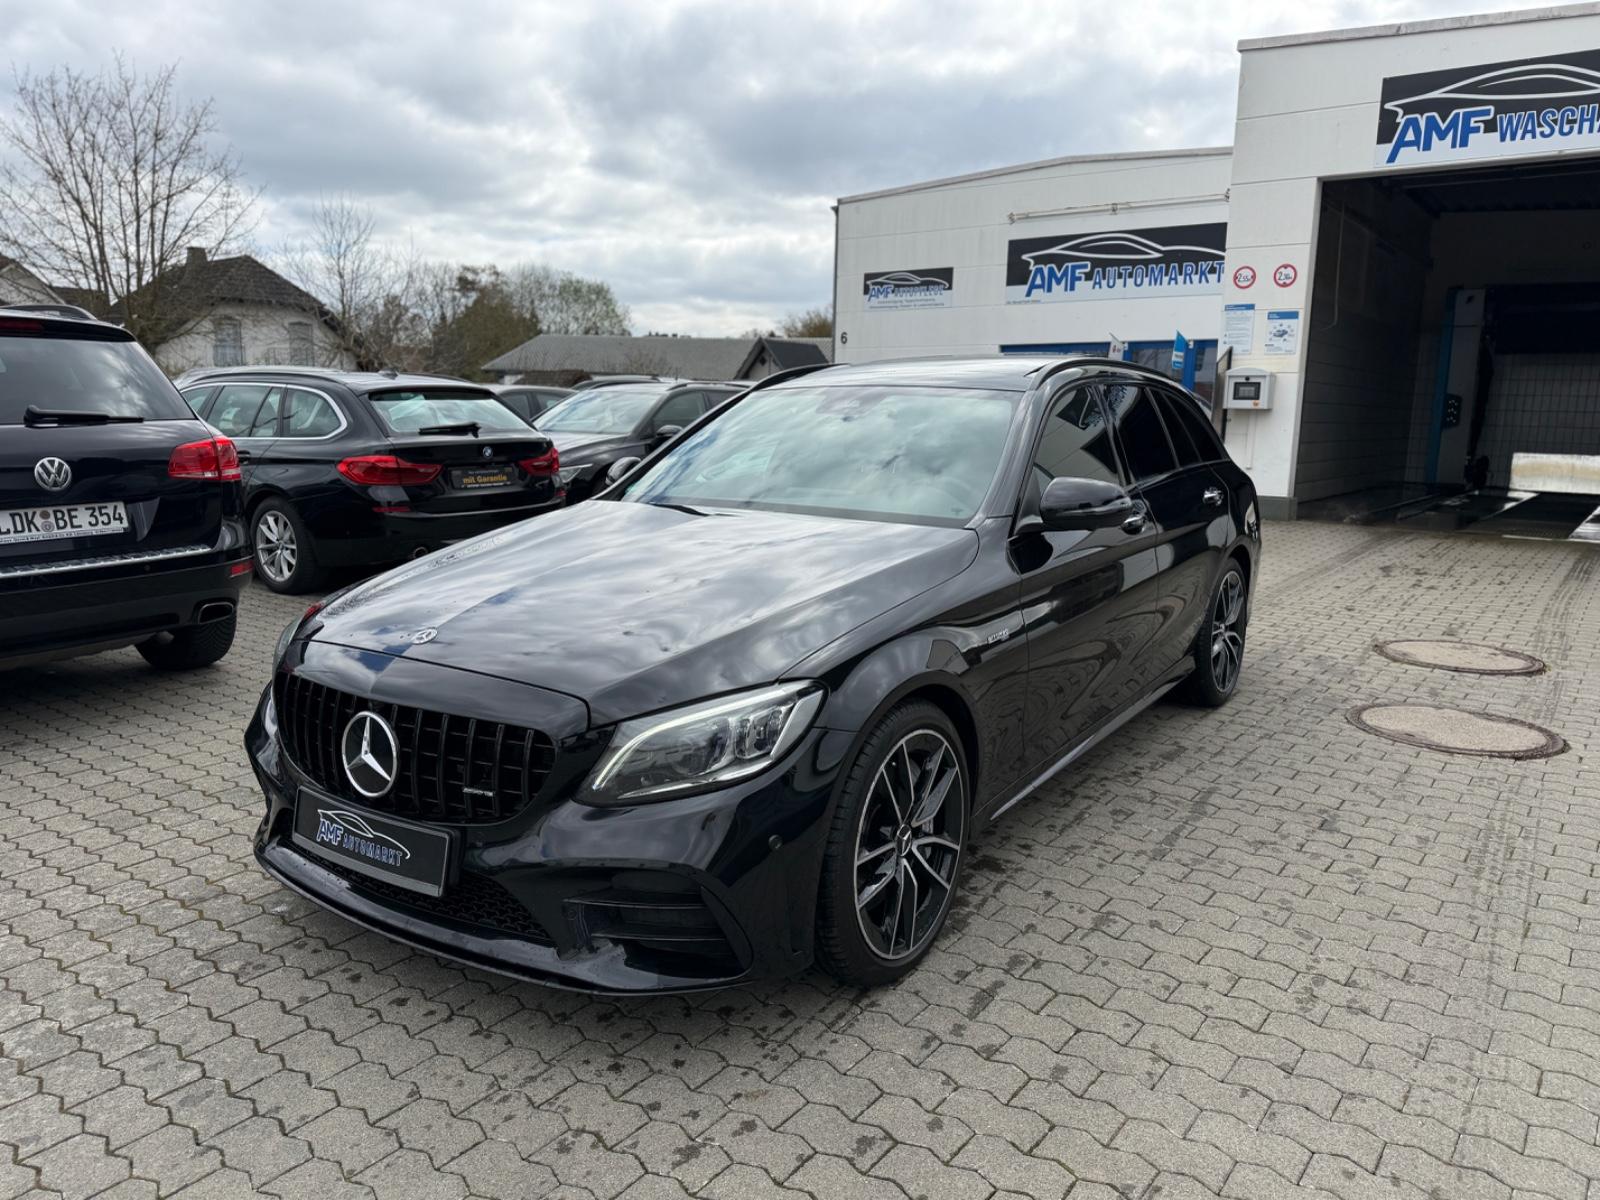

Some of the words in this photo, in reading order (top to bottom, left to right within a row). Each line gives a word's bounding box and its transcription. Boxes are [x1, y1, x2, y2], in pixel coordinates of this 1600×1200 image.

[1386, 105, 1494, 164] AMF
[1498, 104, 1600, 143] WASCH
[1025, 261, 1091, 297] AMF
[1092, 260, 1225, 290] AUTOMARKT
[867, 284, 894, 302] AMF
[840, 331, 848, 345] 6
[53, 508, 82, 530] BE
[85, 504, 124, 527] 354
[316, 818, 344, 845] AMF
